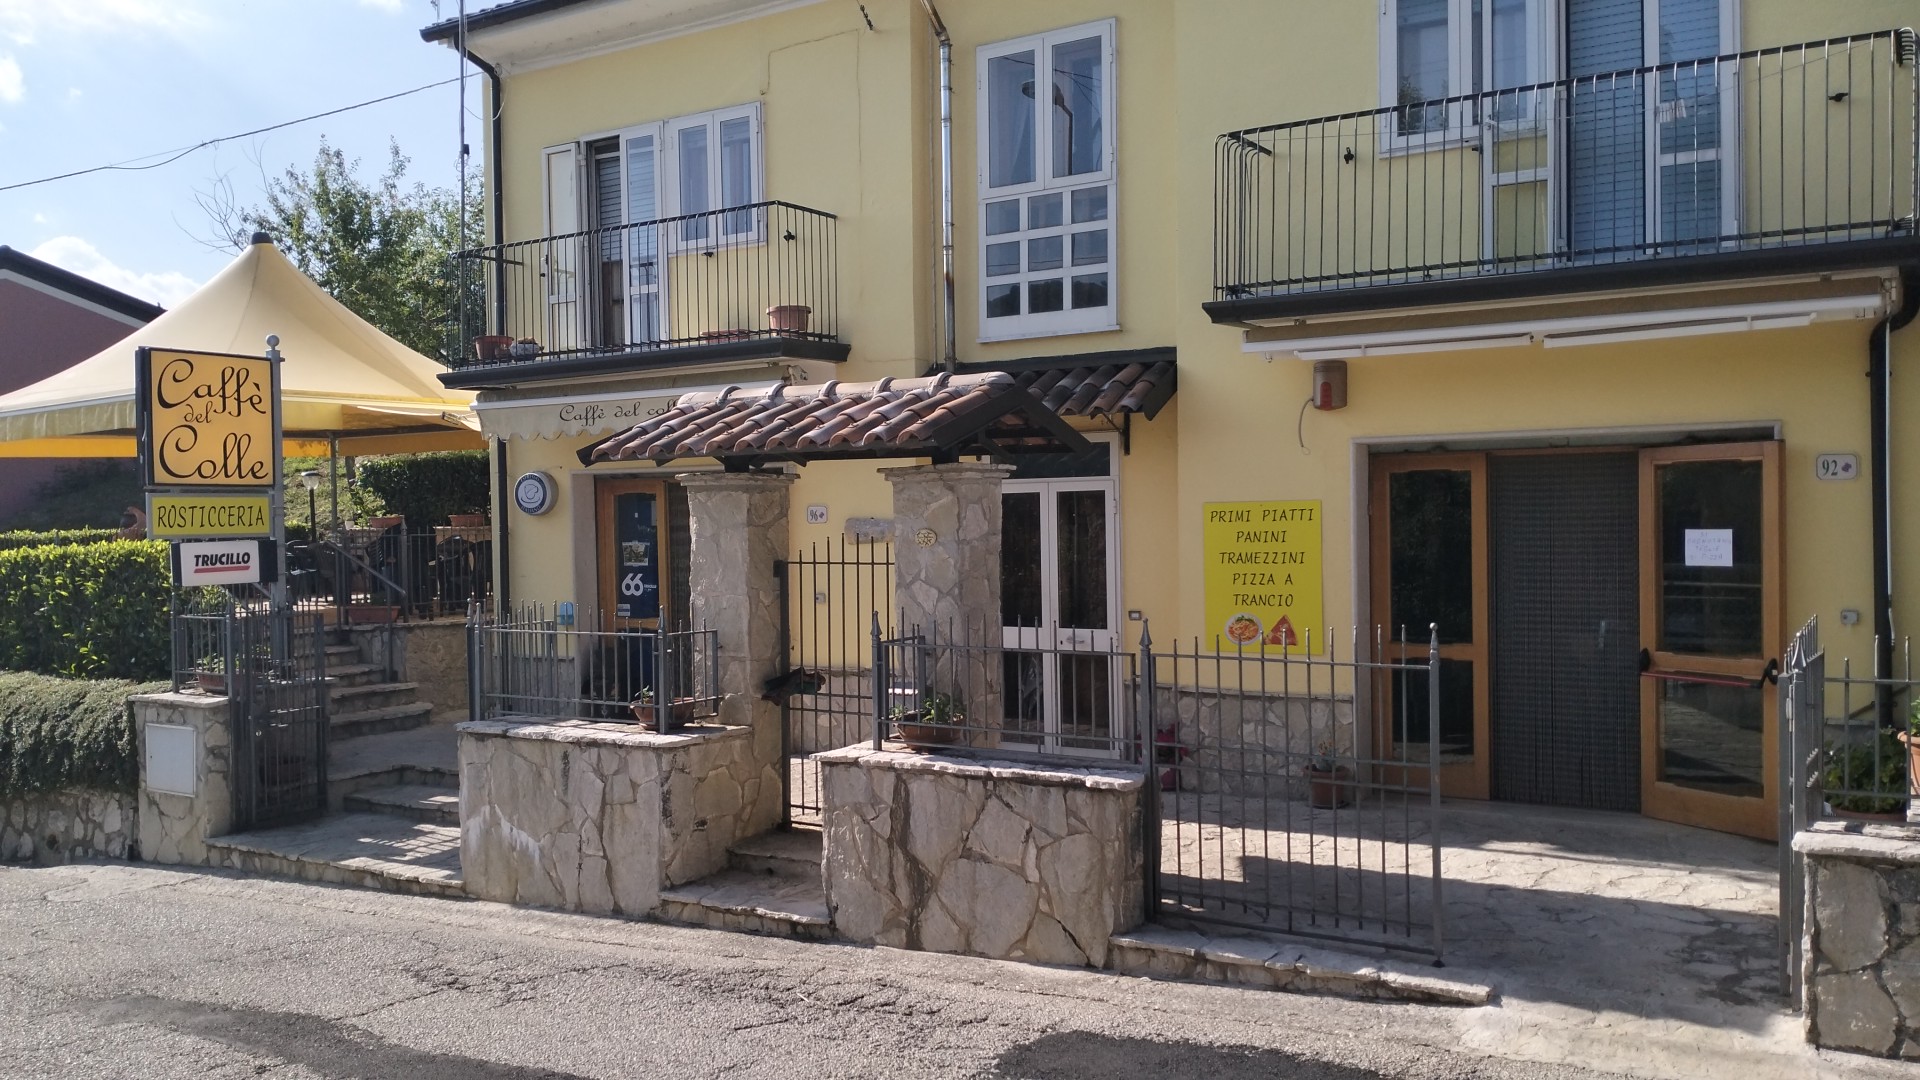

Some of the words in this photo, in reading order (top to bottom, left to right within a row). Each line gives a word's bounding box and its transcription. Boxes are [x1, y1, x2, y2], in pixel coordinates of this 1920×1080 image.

[157, 358, 266, 417] Caffè
[184, 401, 213, 424] del
[559, 405, 606, 427] Caffè
[614, 401, 641, 418] del
[646, 398, 679, 416] coll
[159, 425, 269, 480] Colle
[1822, 458, 1838, 476] 92
[157, 505, 265, 528] ROSTICCERIA
[1210, 510, 1251, 523] PRIMI
[1262, 508, 1314, 522] PIATTI
[1236, 530, 1287, 543] PANINI
[194, 552, 250, 567] TRUCILLO
[1219, 551, 1305, 564] TRAMEZZINI
[622, 573, 644, 596] 66
[1233, 573, 1275, 585] PIZZA
[1285, 573, 1293, 585] A
[1233, 593, 1293, 607] TRANCIO
